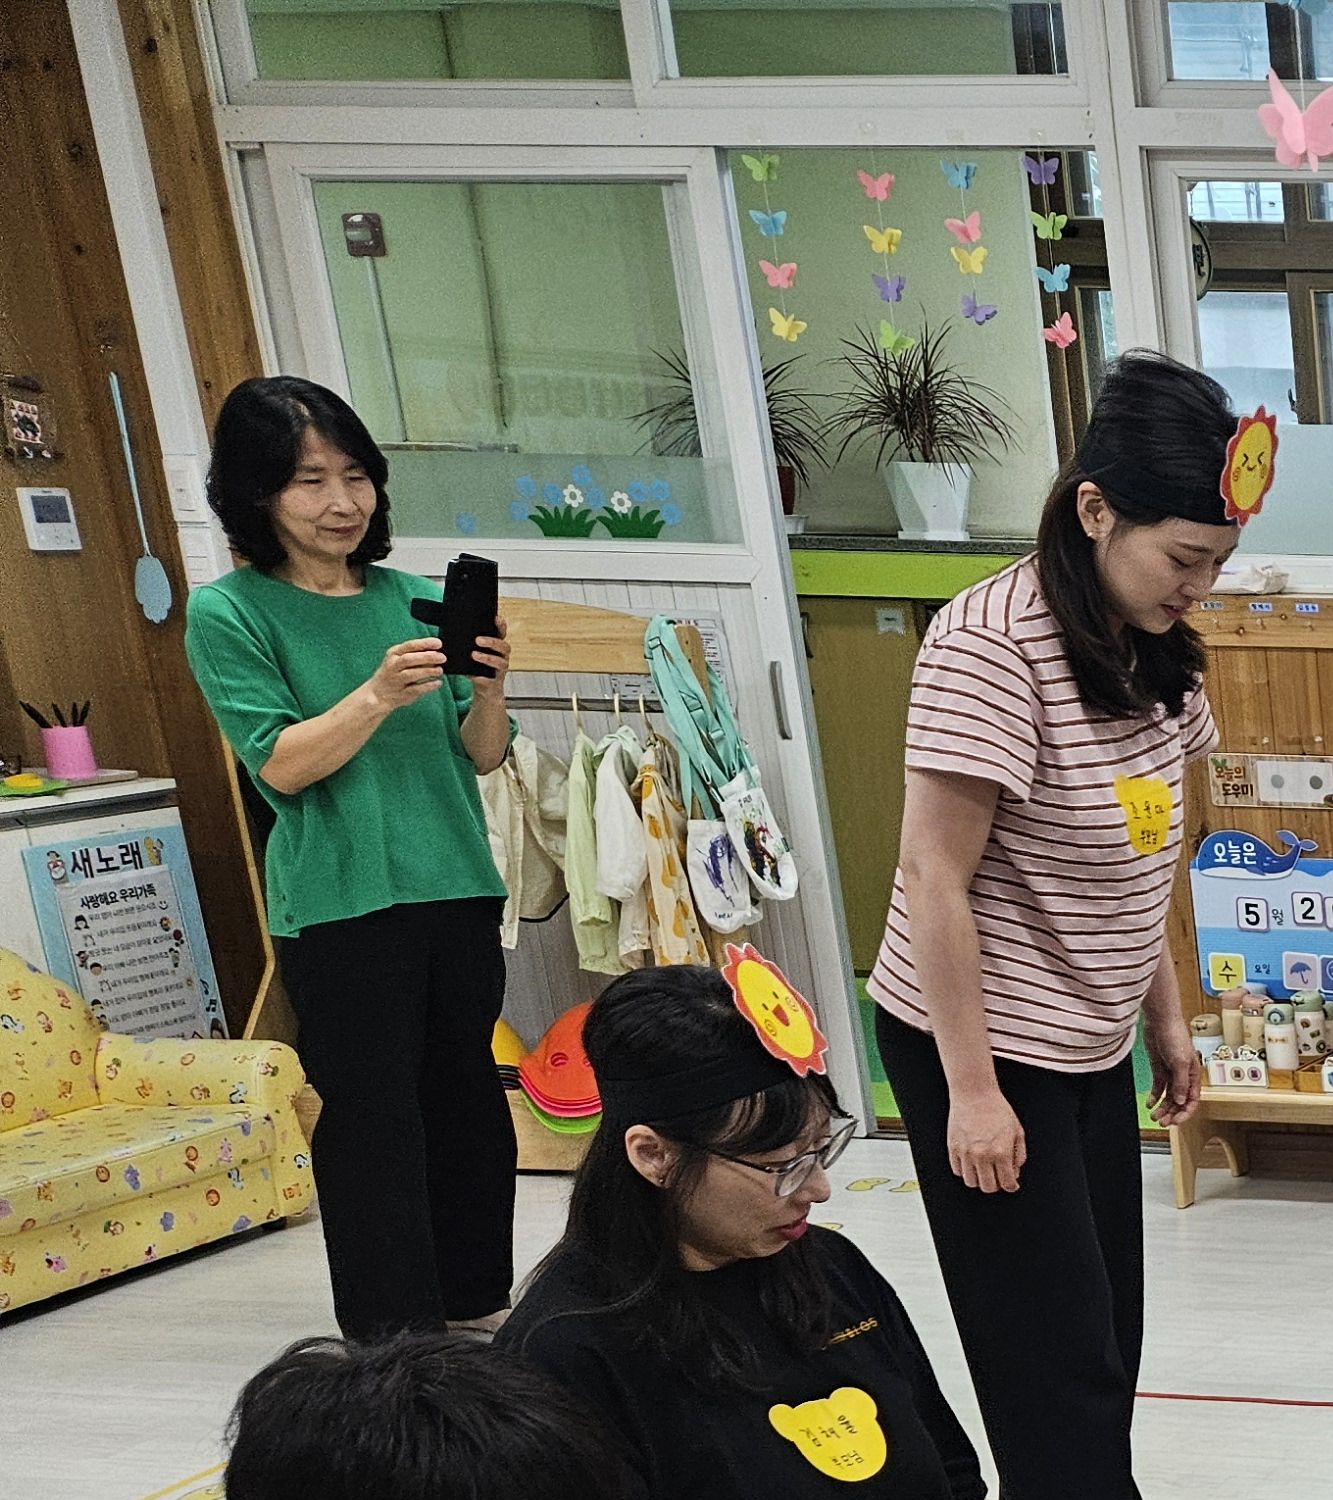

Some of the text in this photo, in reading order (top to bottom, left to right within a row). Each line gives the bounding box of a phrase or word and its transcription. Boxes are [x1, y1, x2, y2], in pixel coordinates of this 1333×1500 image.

[1214, 766, 1246, 781] 오늘의
[1222, 783, 1254, 798] 도우미
[71, 841, 144, 879] 새노래
[1214, 840, 1257, 865] 오늘은
[80, 891, 119, 910] 사랑해요
[1244, 902, 1261, 926] 5
[1271, 908, 1284, 926] 월
[1219, 960, 1271, 983] 수 요일
